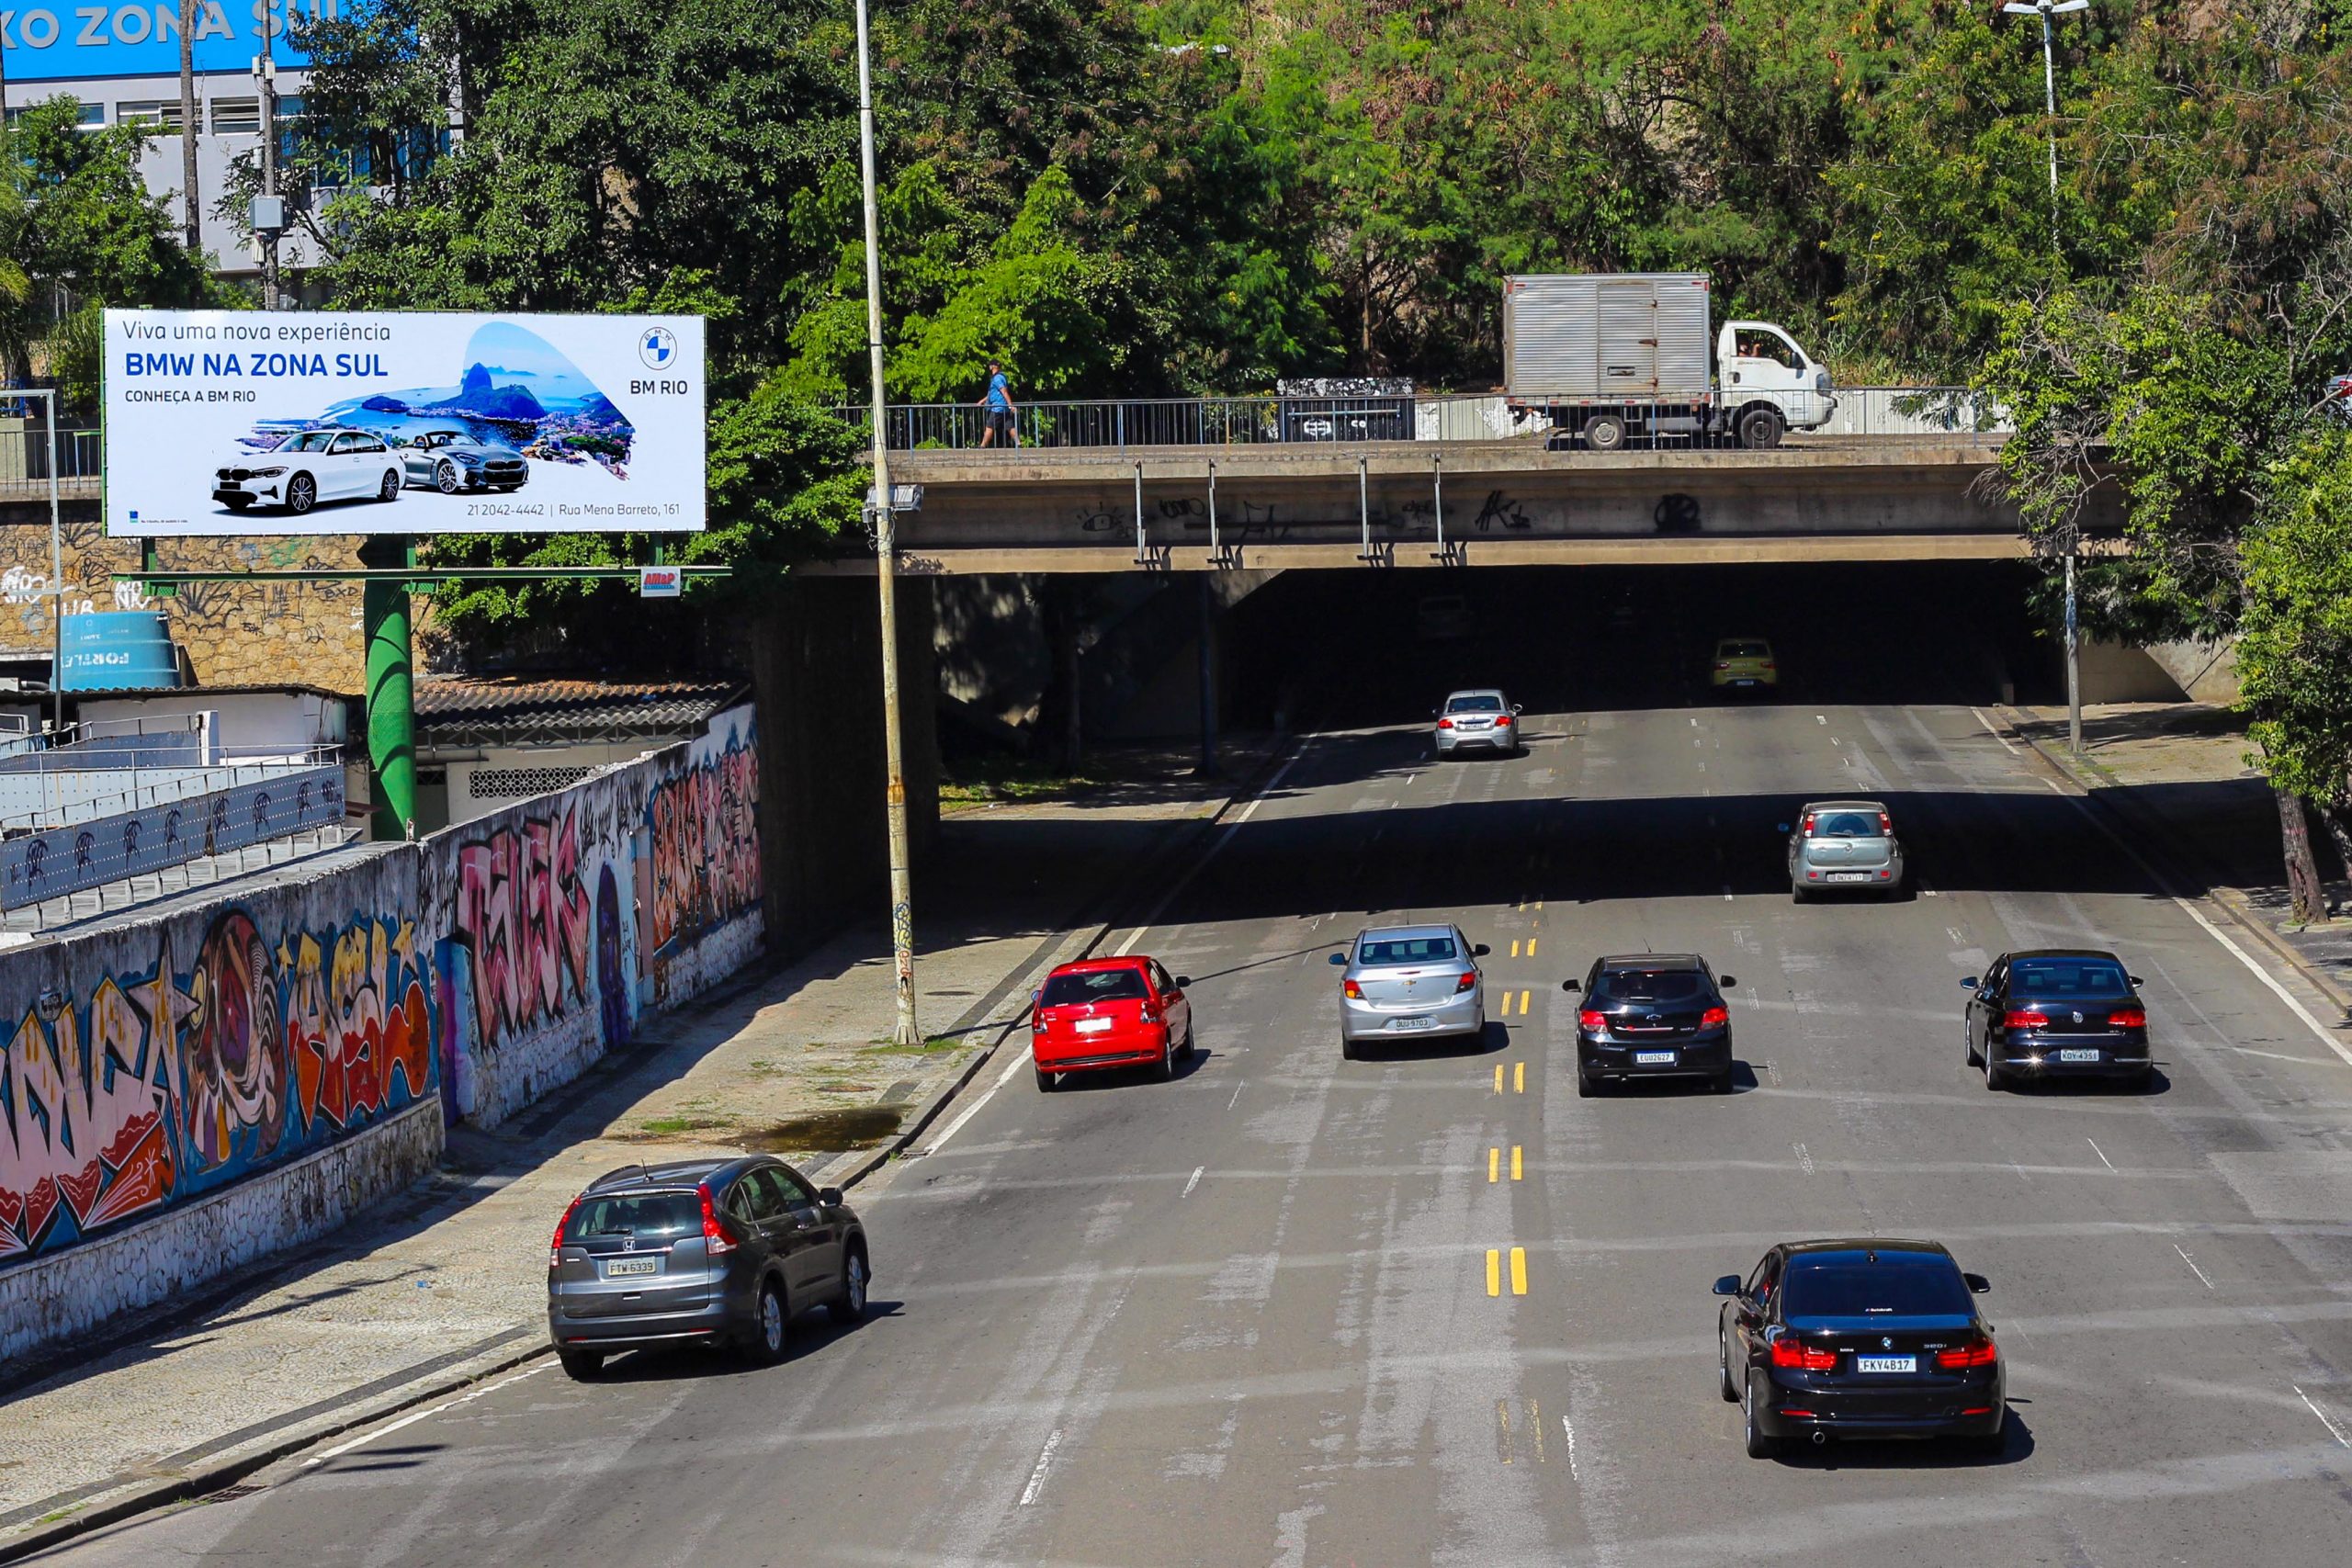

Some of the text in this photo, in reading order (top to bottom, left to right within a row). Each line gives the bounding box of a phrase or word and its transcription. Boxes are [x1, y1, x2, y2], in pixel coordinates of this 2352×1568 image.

[75, 2, 235, 46] ZONA
[122, 321, 390, 344] Viva uma nova experiência
[125, 353, 389, 377] BMW NA ZONA SUL
[630, 380, 688, 395] BM RIO
[125, 390, 256, 405] CONHEÇA A BM RIO
[467, 503, 680, 517] 21 2042-4442 Rua Mena Barreto, 161
[1863, 1359, 1910, 1371] FKY4B17
